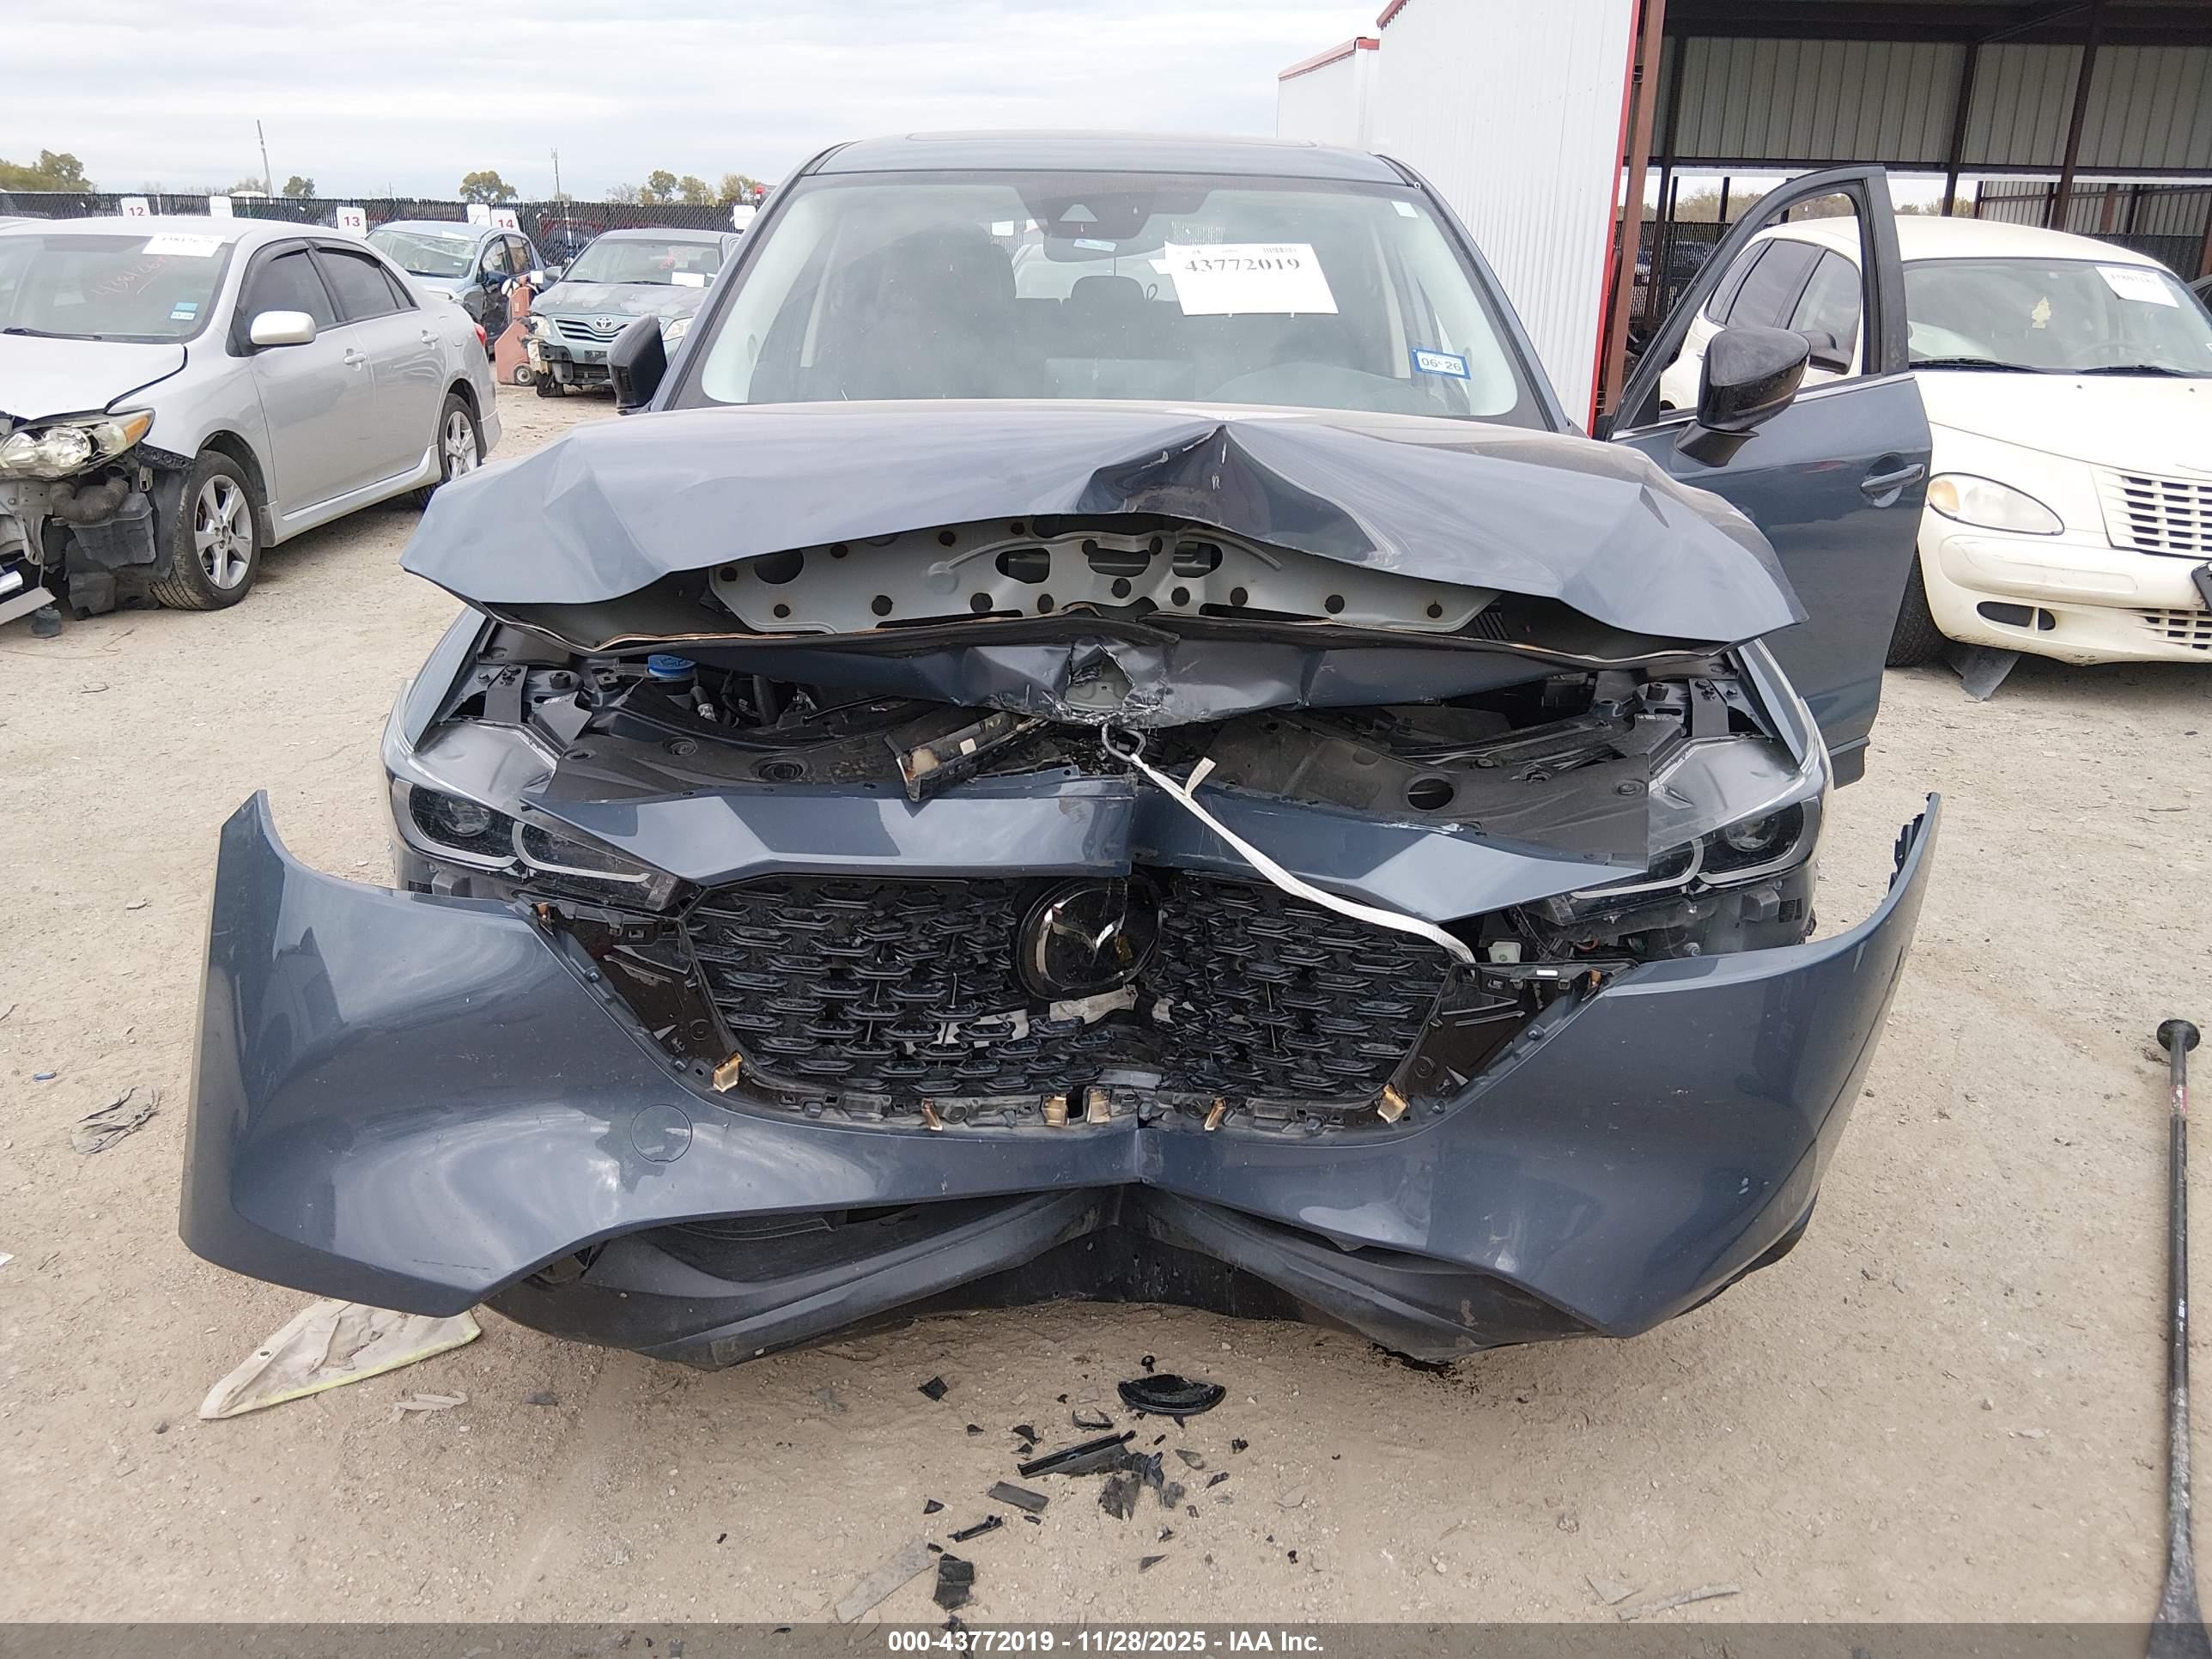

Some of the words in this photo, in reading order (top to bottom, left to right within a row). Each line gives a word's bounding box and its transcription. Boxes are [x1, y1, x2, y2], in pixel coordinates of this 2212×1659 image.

[129, 207, 144, 216] 12
[344, 216, 360, 227] 13
[498, 219, 514, 229] 14
[1185, 258, 1300, 272] 43772019
